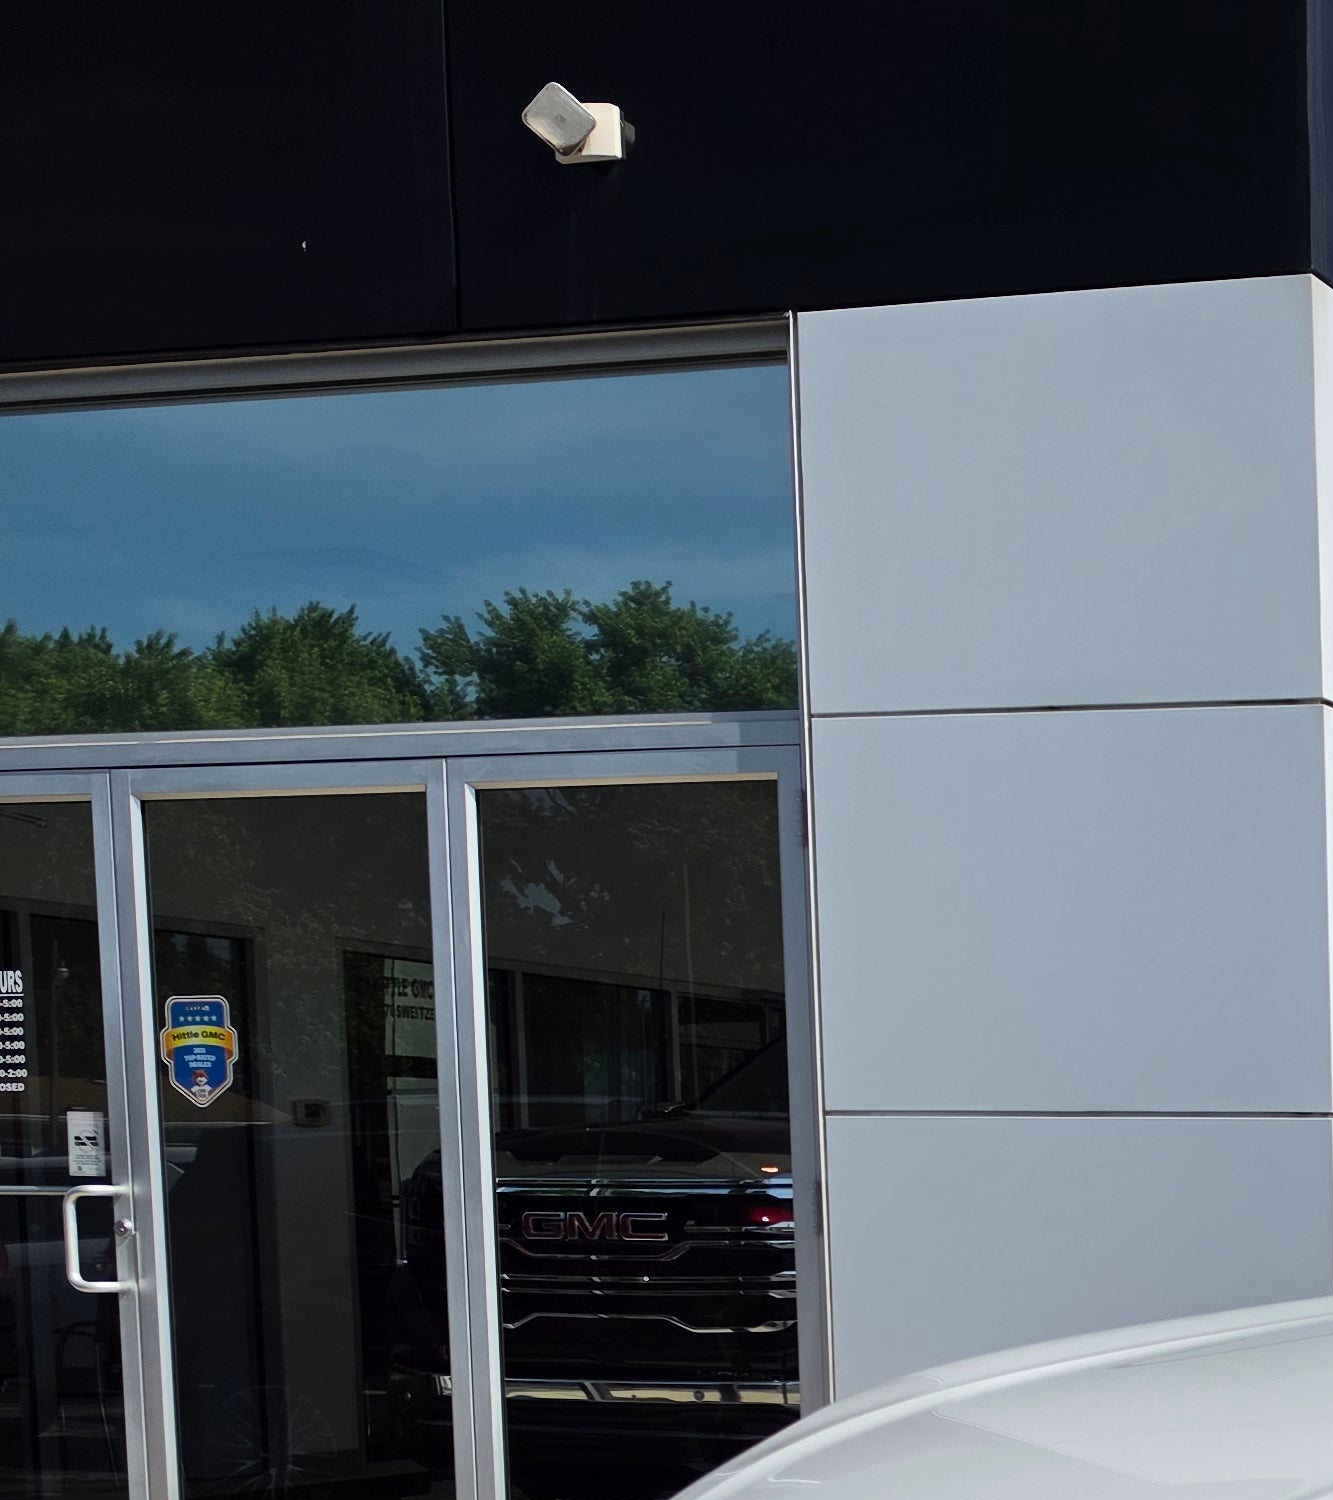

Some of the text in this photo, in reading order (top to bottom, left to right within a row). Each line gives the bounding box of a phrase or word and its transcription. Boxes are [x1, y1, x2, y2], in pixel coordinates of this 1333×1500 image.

[172, 1031, 226, 1041] Hittle GMC
[521, 1211, 668, 1241] GMC
